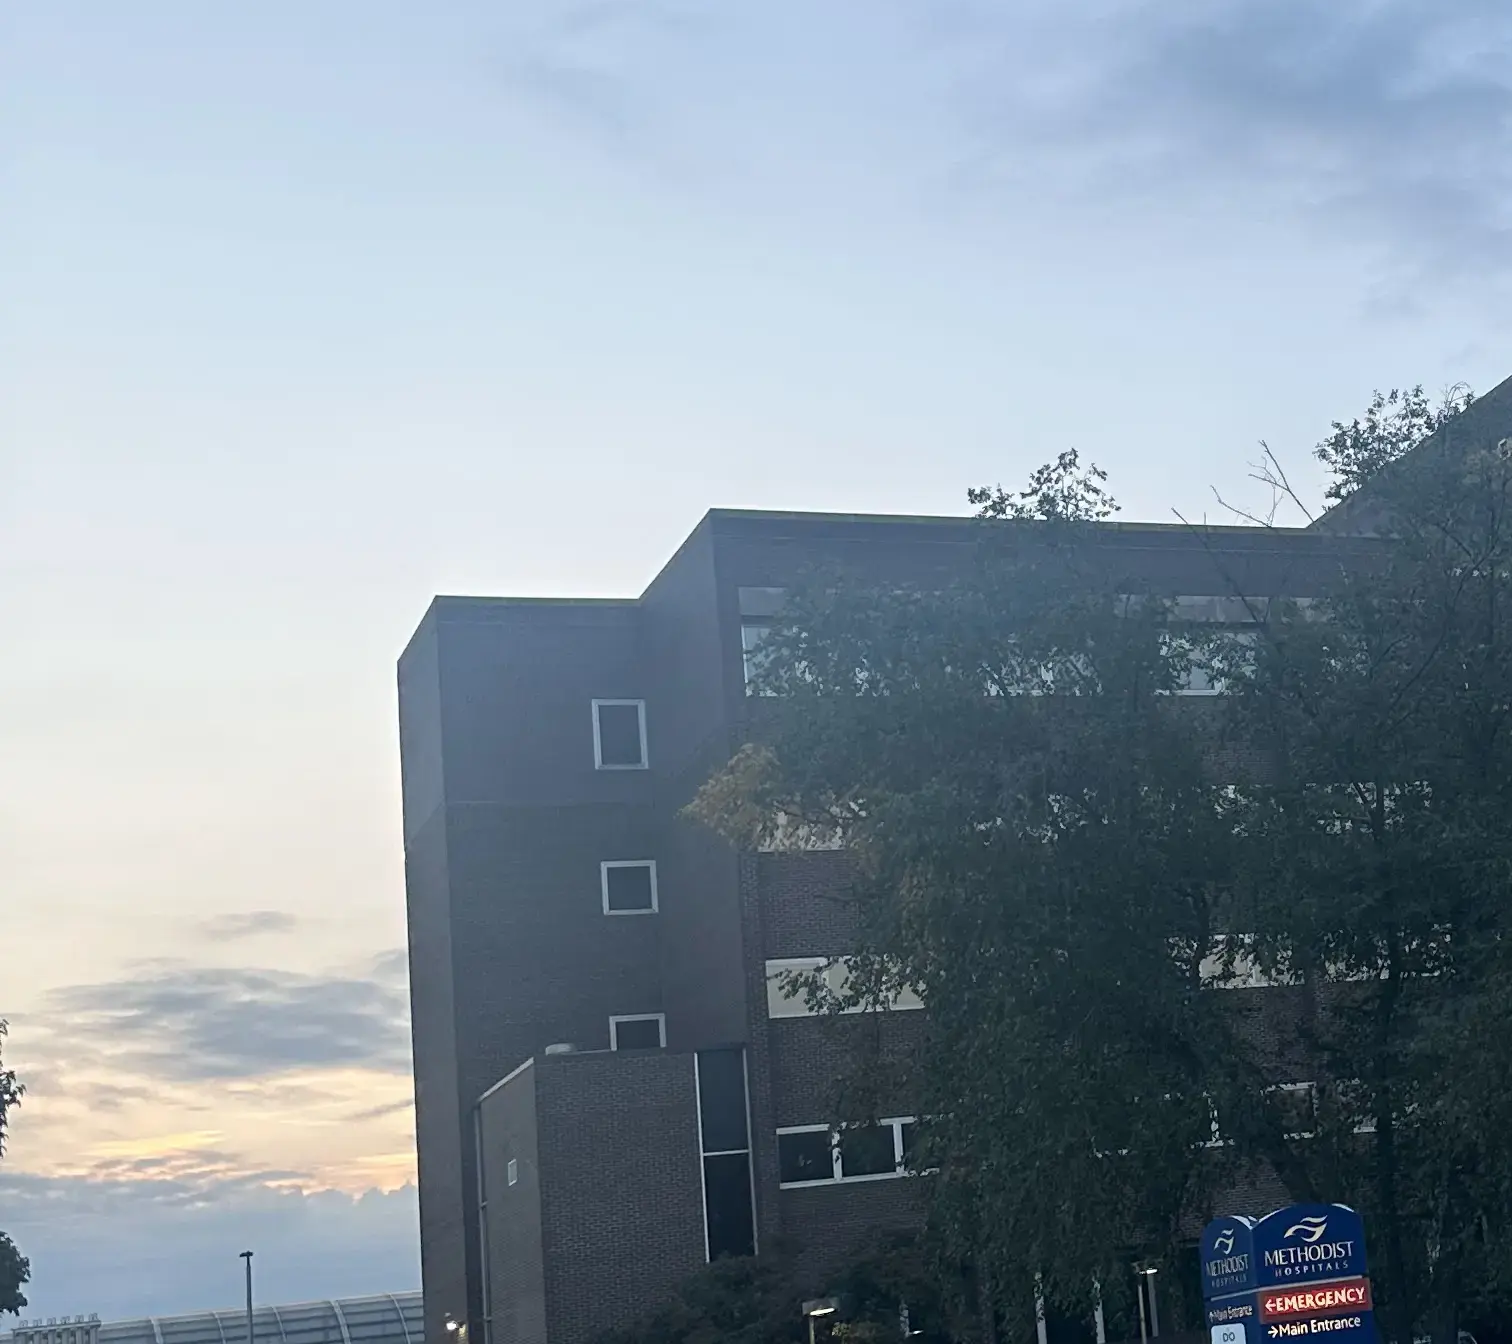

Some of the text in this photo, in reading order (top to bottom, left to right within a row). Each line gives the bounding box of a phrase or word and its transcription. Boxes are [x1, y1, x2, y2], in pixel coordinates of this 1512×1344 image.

[1264, 1240, 1355, 1266] METHODIST
[1275, 1260, 1349, 1278] HOSPITALS
[1276, 1287, 1365, 1312] EMERGENCY
[1223, 1332, 1235, 1342] DO
[1279, 1315, 1361, 1338] Main Entrance
